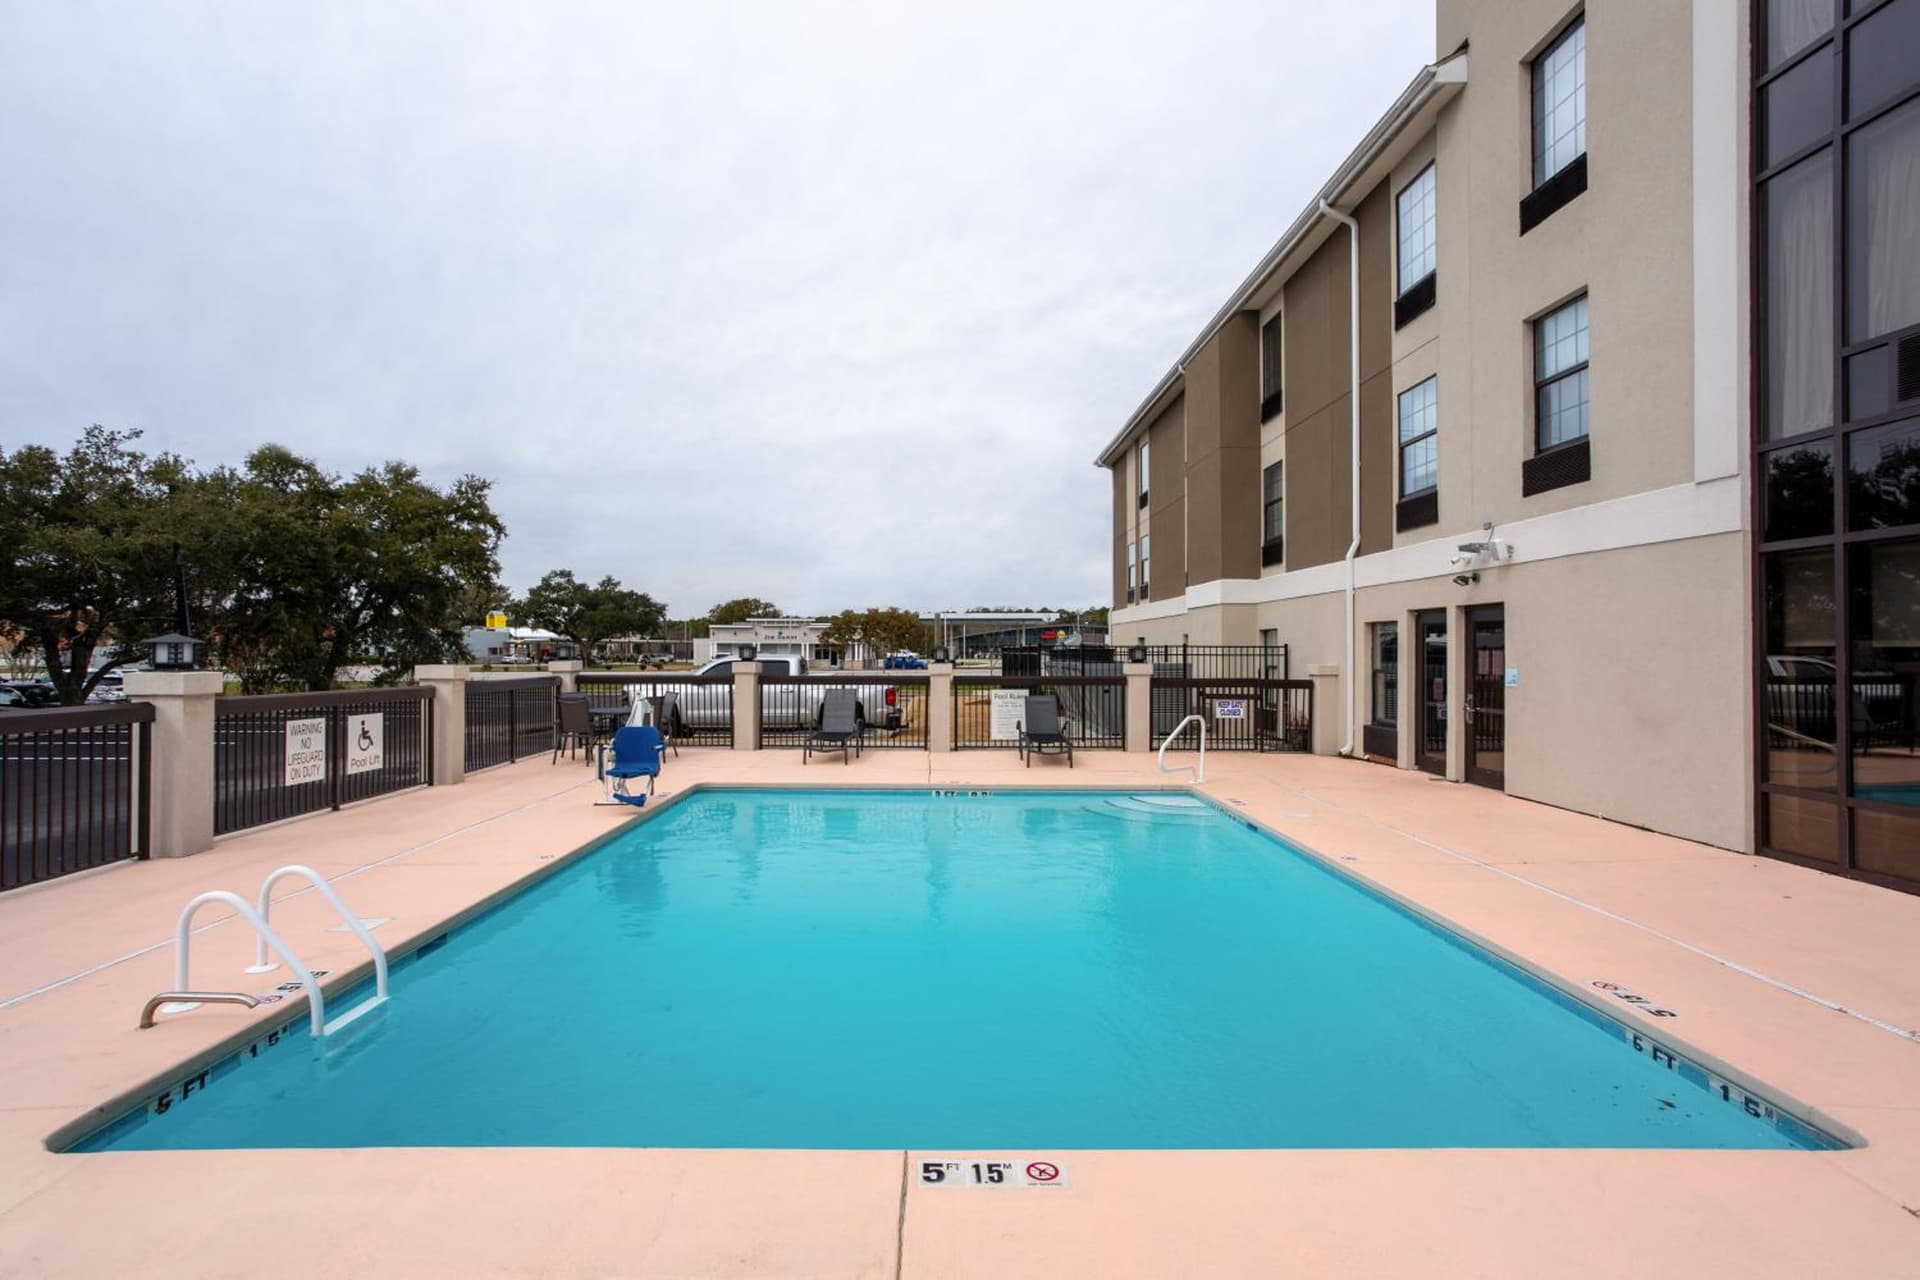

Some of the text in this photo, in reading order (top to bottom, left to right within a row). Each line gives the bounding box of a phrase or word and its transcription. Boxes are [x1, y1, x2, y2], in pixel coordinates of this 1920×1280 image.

[289, 722, 323, 737] WARNING
[301, 737, 312, 750] NO
[287, 750, 323, 767] LIFEGUARD
[350, 754, 380, 769] Pool Lift
[290, 764, 321, 780] ON DUTY
[1652, 1045, 1676, 1070] FT
[182, 1069, 209, 1100] FT
